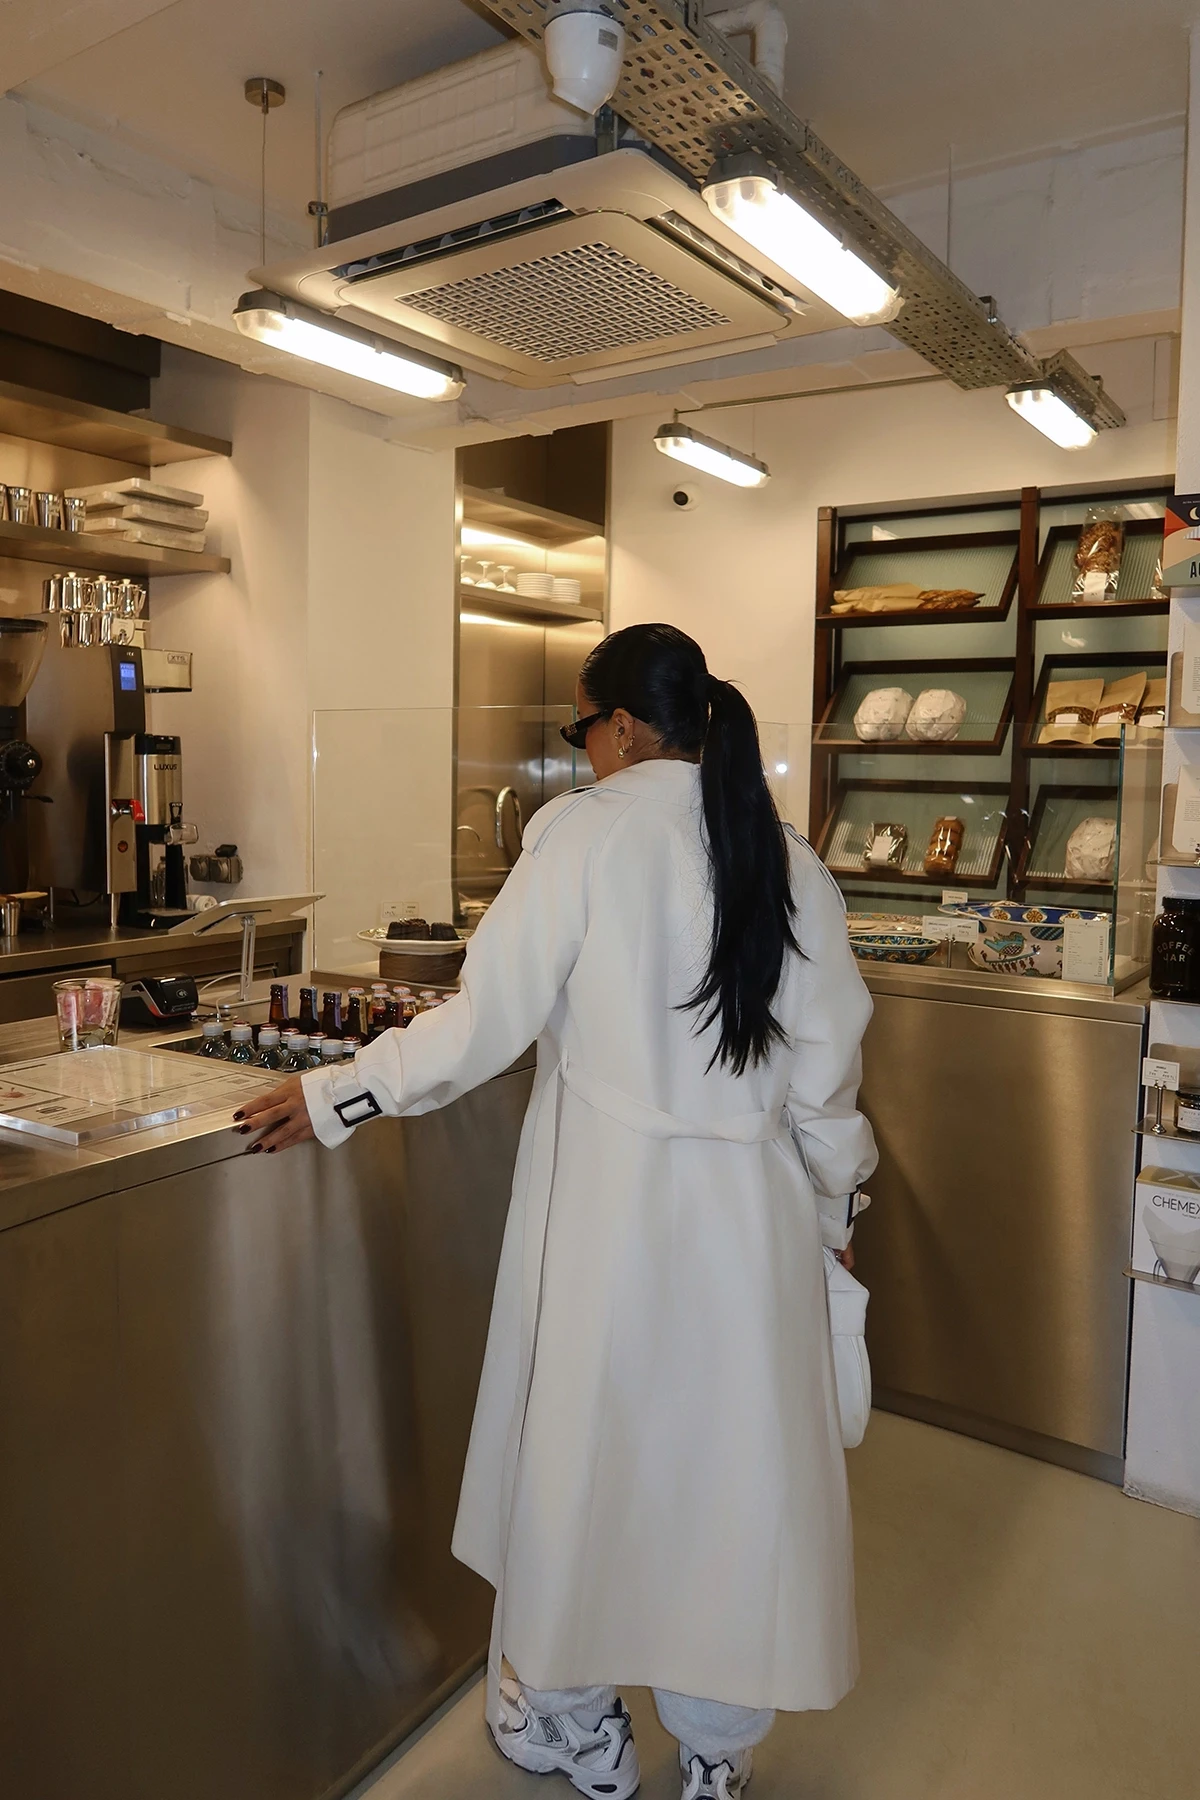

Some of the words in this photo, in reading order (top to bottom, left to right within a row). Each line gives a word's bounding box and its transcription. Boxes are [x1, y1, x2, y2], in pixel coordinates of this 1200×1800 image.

[1190, 561, 1200, 578] A
[153, 763, 177, 771] LUXUS
[1157, 941, 1194, 956] COFFEE
[1163, 953, 1186, 962] JAR
